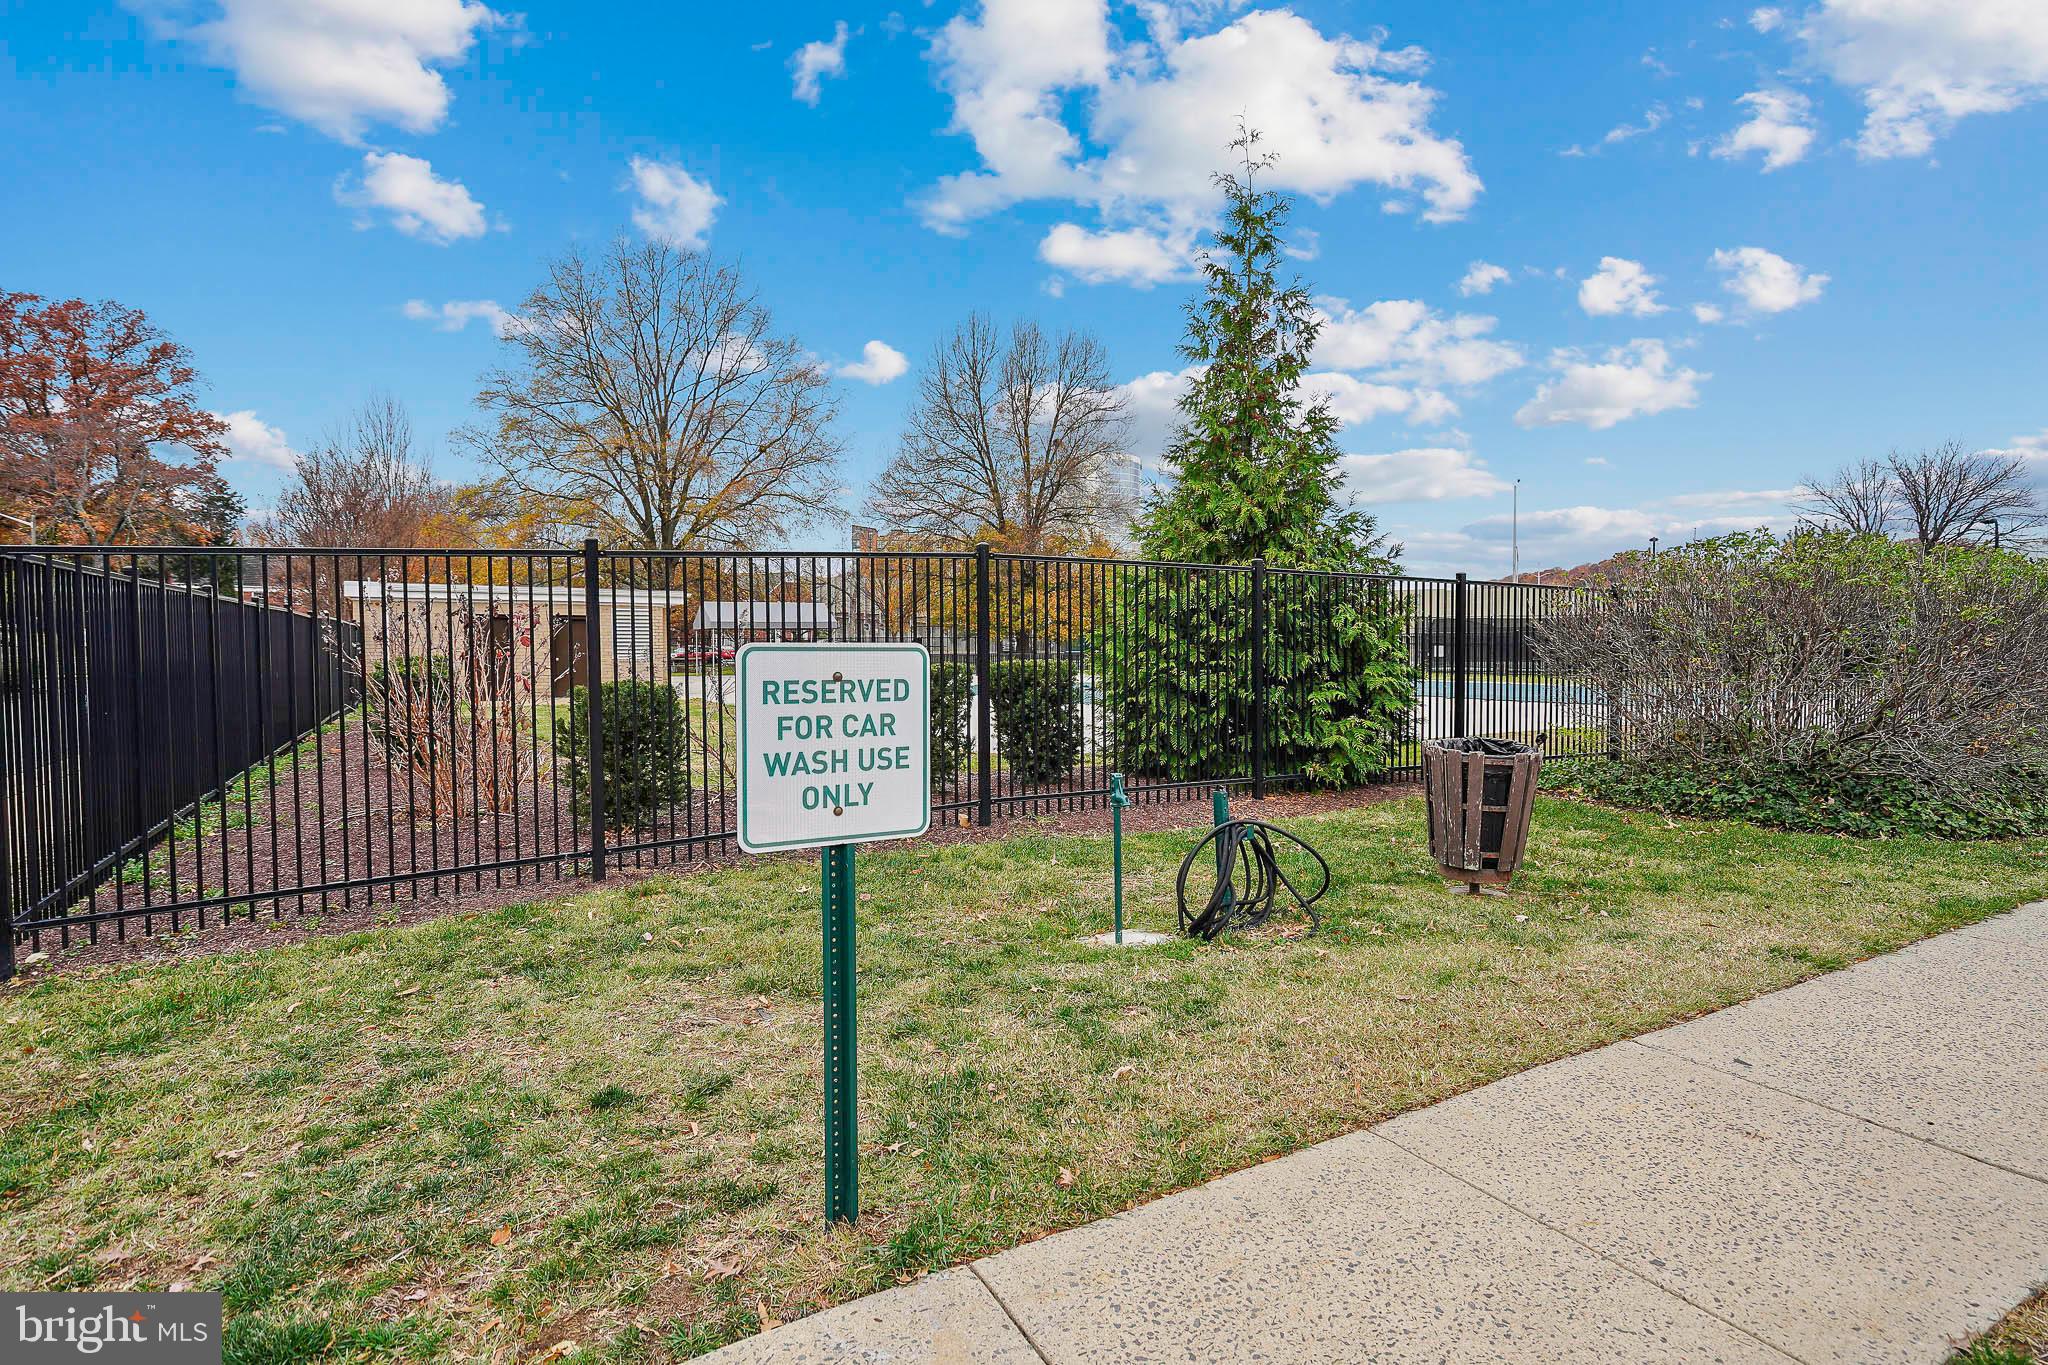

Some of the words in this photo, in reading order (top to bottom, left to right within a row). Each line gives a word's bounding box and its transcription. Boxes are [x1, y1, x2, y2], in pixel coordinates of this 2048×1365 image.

[762, 678, 910, 705] RESERVED
[777, 714, 833, 740] FOR
[842, 713, 897, 738] CAR
[762, 749, 848, 777] WASH
[858, 746, 910, 772] USE
[802, 782, 874, 810] ONLY
